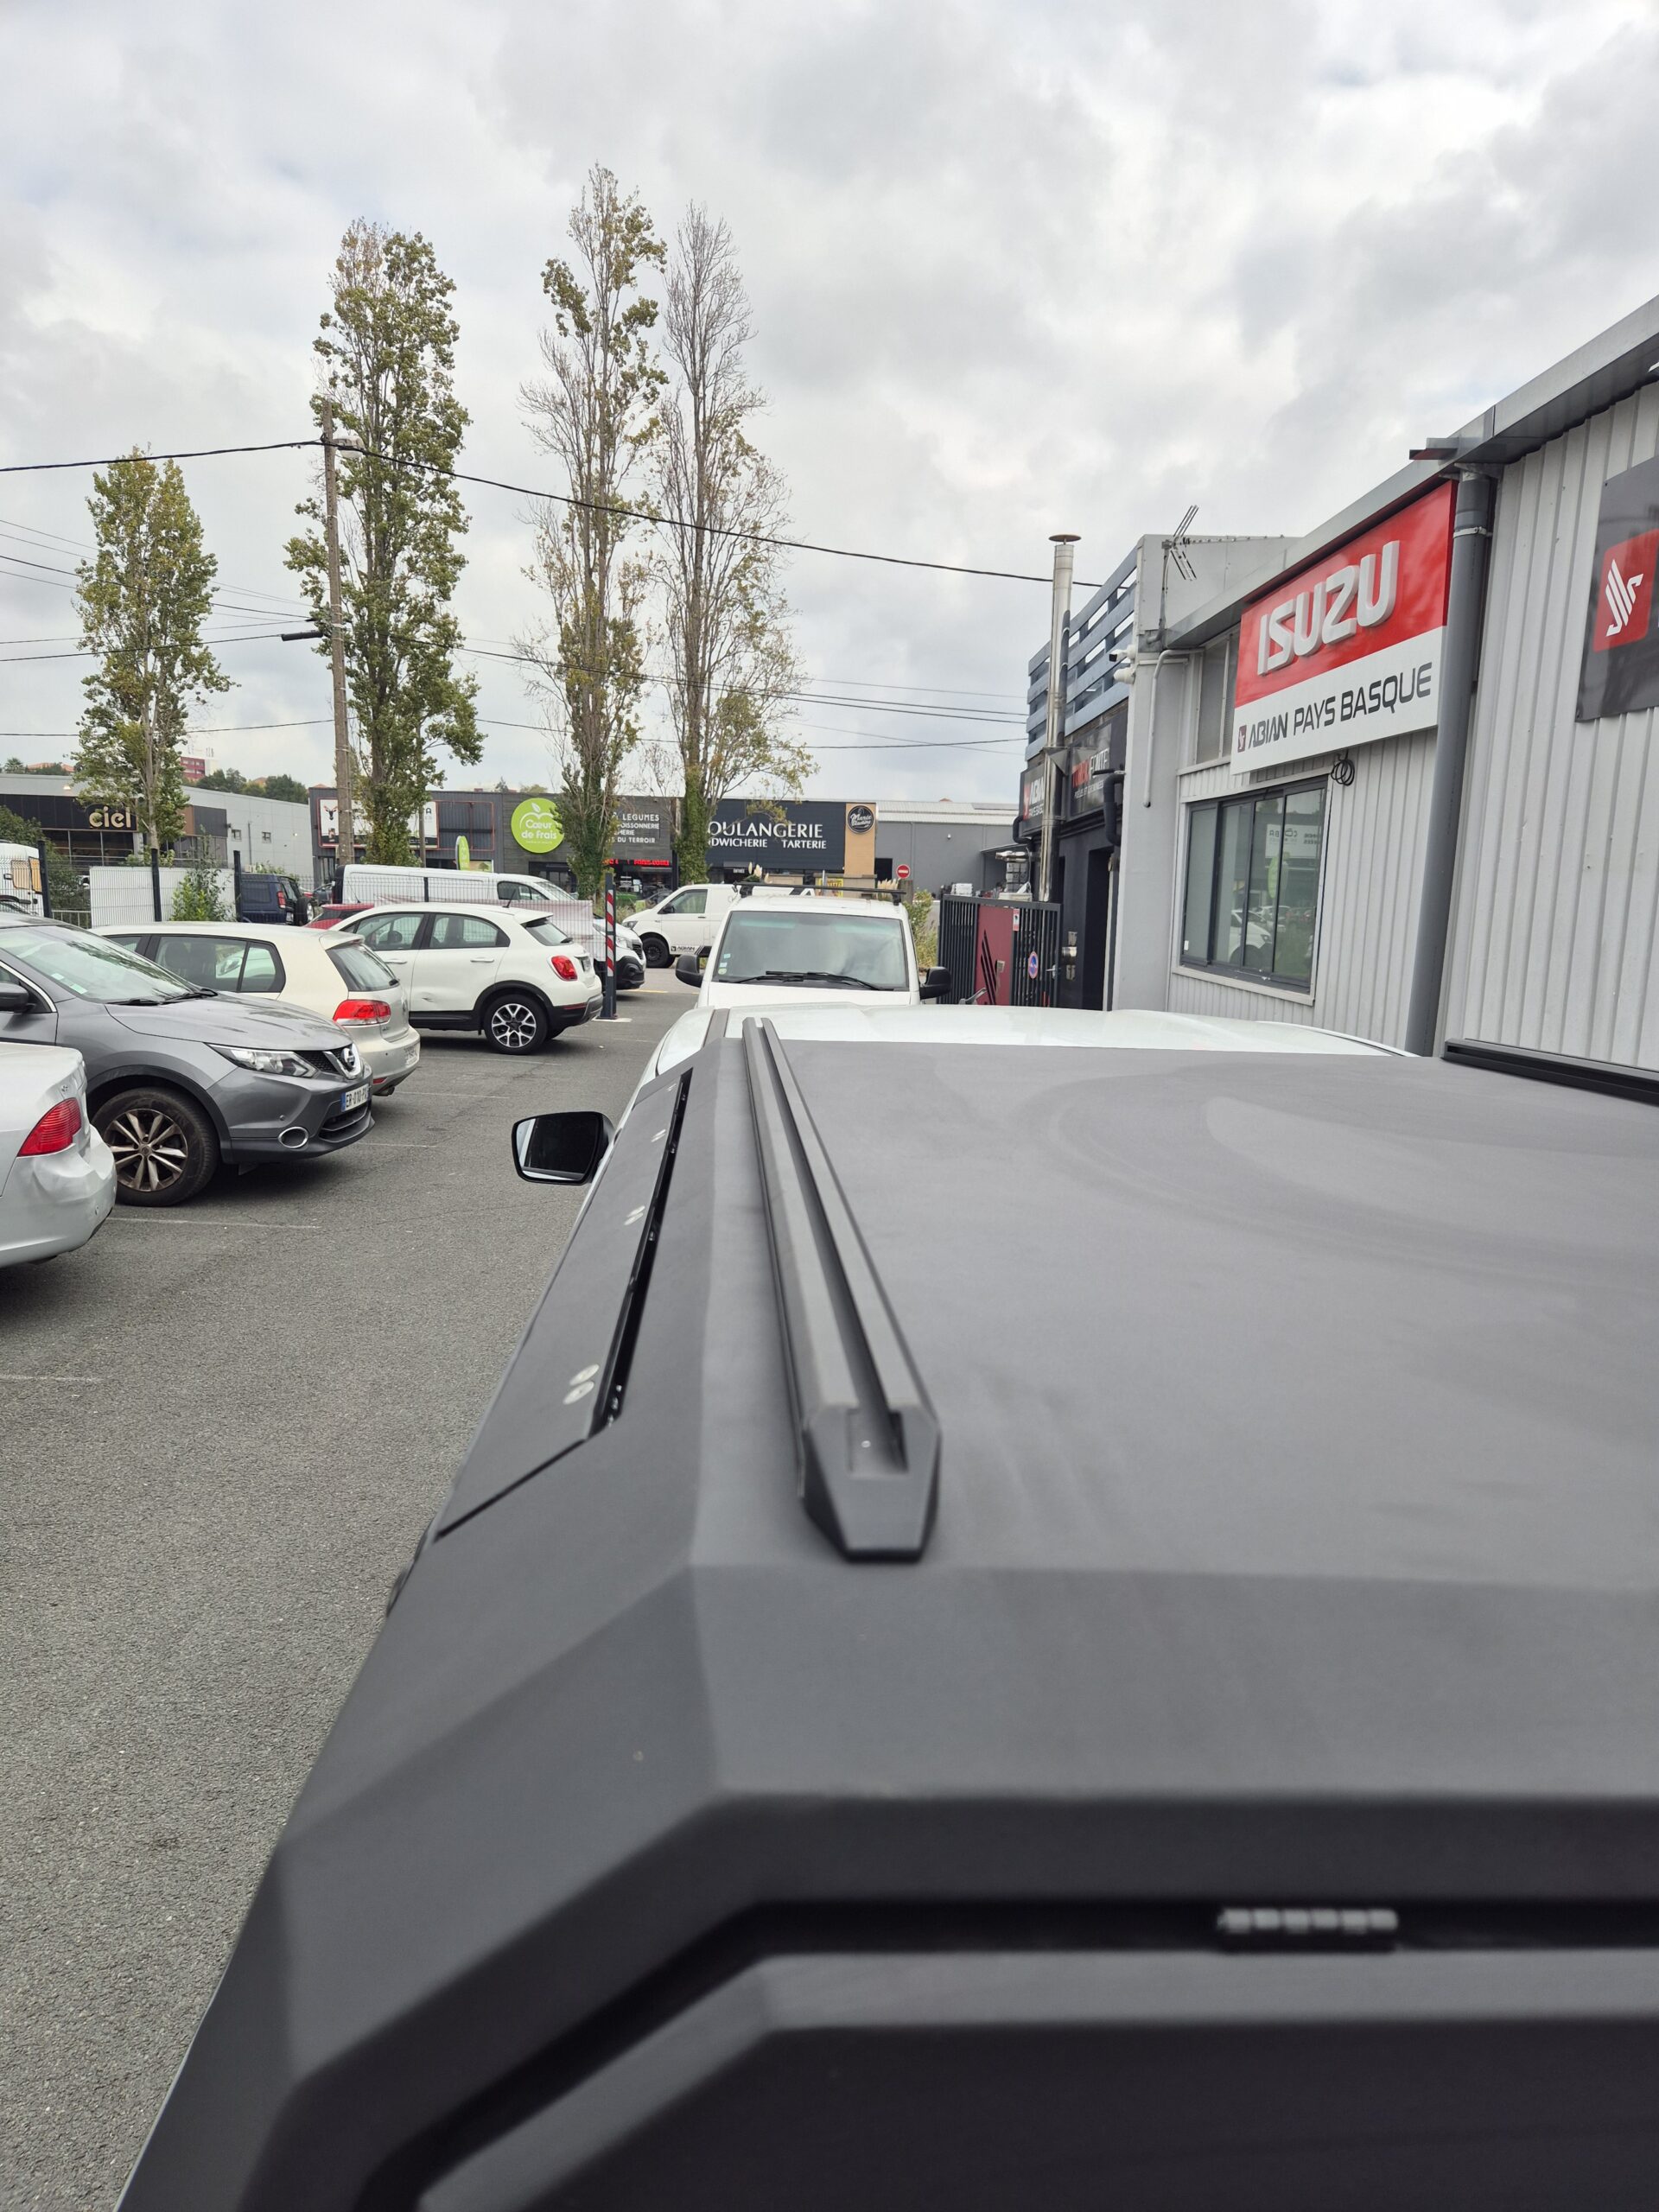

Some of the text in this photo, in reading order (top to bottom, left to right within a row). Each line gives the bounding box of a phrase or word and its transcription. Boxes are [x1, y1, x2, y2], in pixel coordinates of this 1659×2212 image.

[1257, 540, 1400, 676] ISUZU
[1248, 662, 1433, 749] ABIAN PAYS BASQUE
[89, 805, 131, 828] ciel
[521, 830, 557, 840] de frais
[708, 821, 823, 838] OULANGERIE
[709, 837, 826, 849] DWICHERIE TARTERIE
